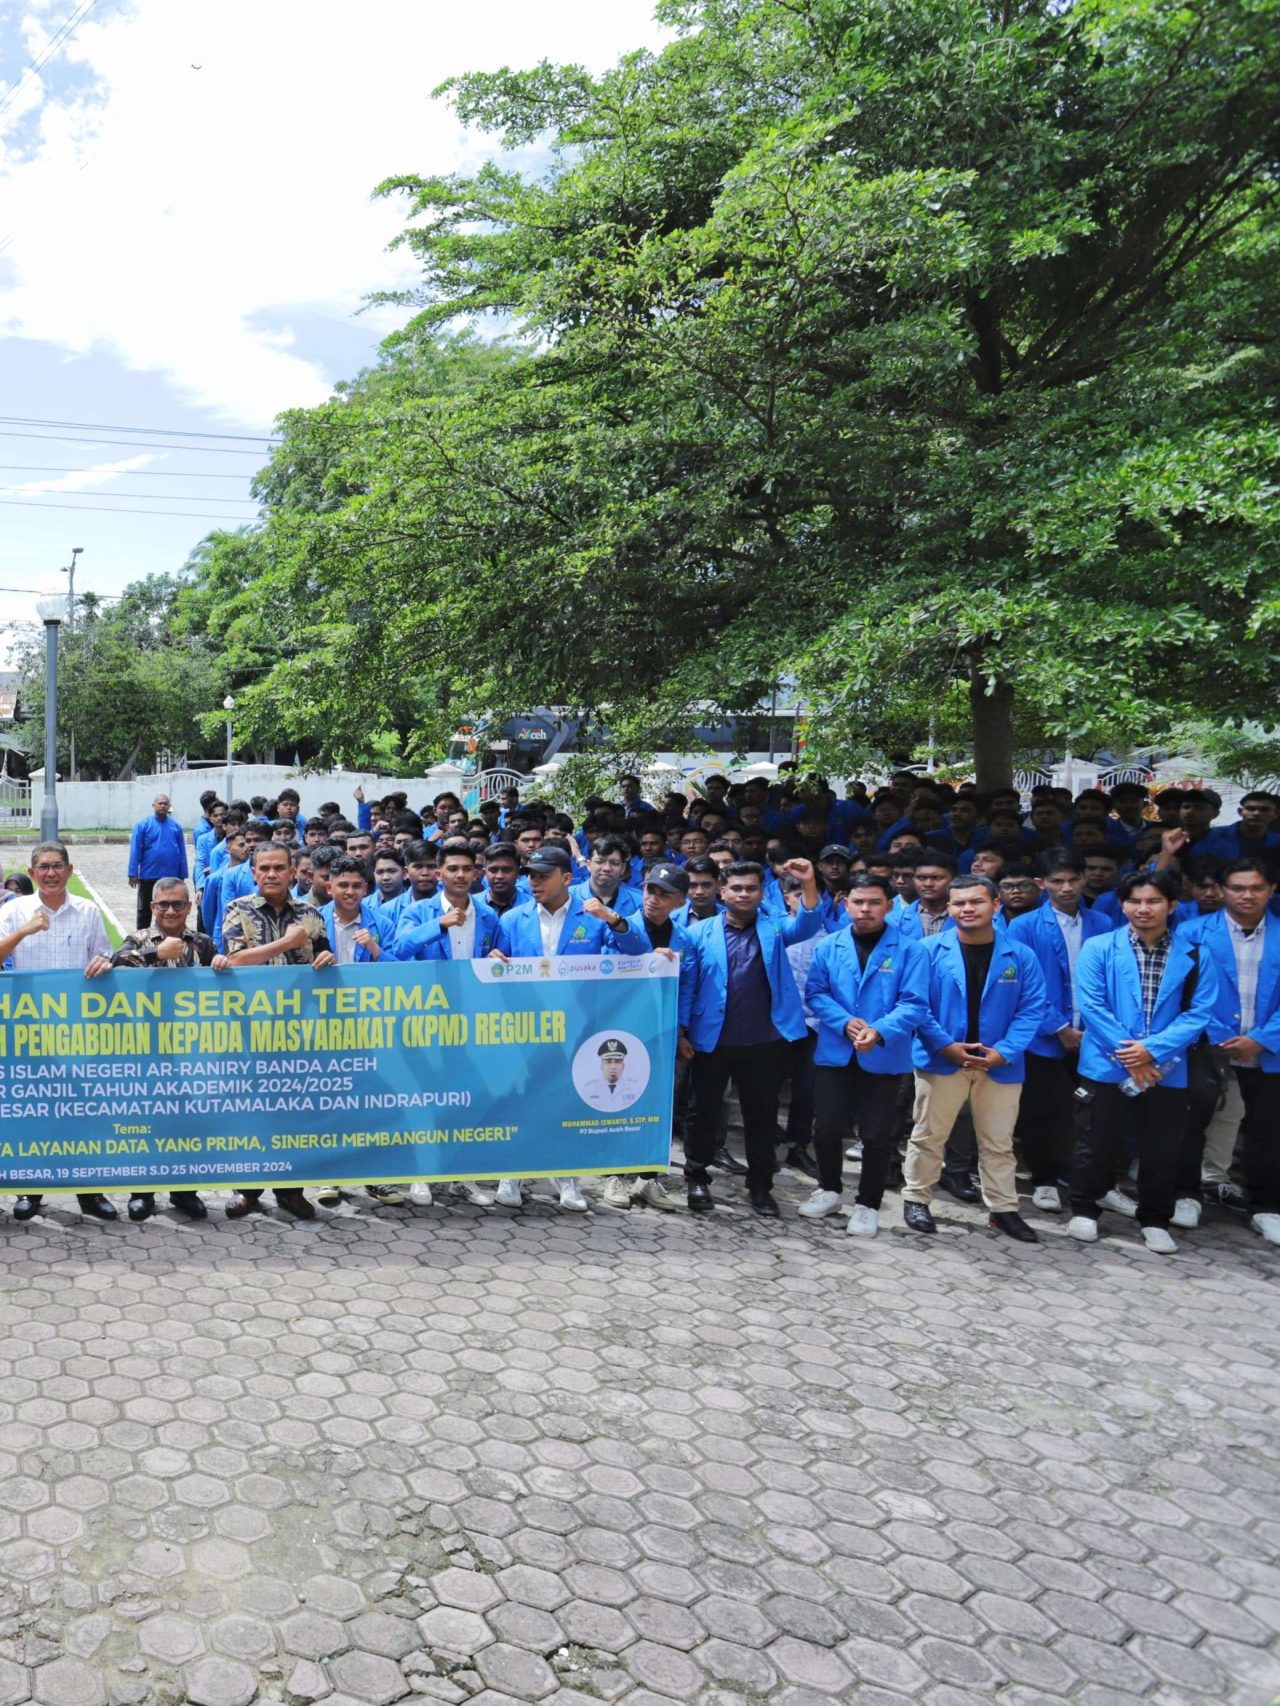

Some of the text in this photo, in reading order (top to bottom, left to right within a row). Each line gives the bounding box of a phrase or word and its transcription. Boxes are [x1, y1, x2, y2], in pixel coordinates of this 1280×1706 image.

[506, 964, 532, 974] P2M
[570, 963, 597, 972] pusaka
[81, 991, 161, 1018] DAN
[174, 989, 300, 1017] SERAH
[312, 984, 449, 1013] TERIMA
[14, 1021, 150, 1057] PENGABDIAN
[158, 1020, 243, 1054] KEPADA
[250, 1016, 396, 1052] MASYARAKAT
[402, 1014, 468, 1047] (KPM)
[475, 1010, 566, 1045] REGULER
[11, 1064, 66, 1079] ISLAM
[72, 1063, 141, 1078] NEGERI
[147, 1060, 250, 1077] AR-RANIRY
[256, 1058, 323, 1074] BANDA
[327, 1057, 377, 1072] ACEH
[11, 1083, 77, 1098] GANJIL
[81, 1082, 147, 1097] TAHUN
[152, 1079, 253, 1096] AKADEMIK
[258, 1076, 353, 1093] 2024/2025
[55, 1100, 179, 1118] (KECAMATAN
[185, 1096, 314, 1114] KUTAMALAKA
[320, 1094, 359, 1110] DAN
[364, 1091, 471, 1108] INDRAPURI)
[113, 1123, 151, 1135] Tema:
[562, 1119, 599, 1128] MUHAMMAD
[19, 1139, 102, 1157] LAYANAN
[106, 1138, 147, 1154] DATA
[155, 1137, 202, 1153] YANG
[207, 1135, 266, 1152] PRIMA,
[271, 1133, 337, 1150] SINERGI
[342, 1129, 449, 1147] MEMBANGUN
[453, 1126, 518, 1143] NEGERI"
[10, 1169, 55, 1181] BESAR,
[56, 1168, 69, 1178] 19
[72, 1166, 147, 1178] SEPTEMBER
[150, 1165, 169, 1176] S.D
[172, 1165, 186, 1175] 25
[189, 1163, 260, 1174] NOVEMBER
[263, 1162, 292, 1173] 2024
